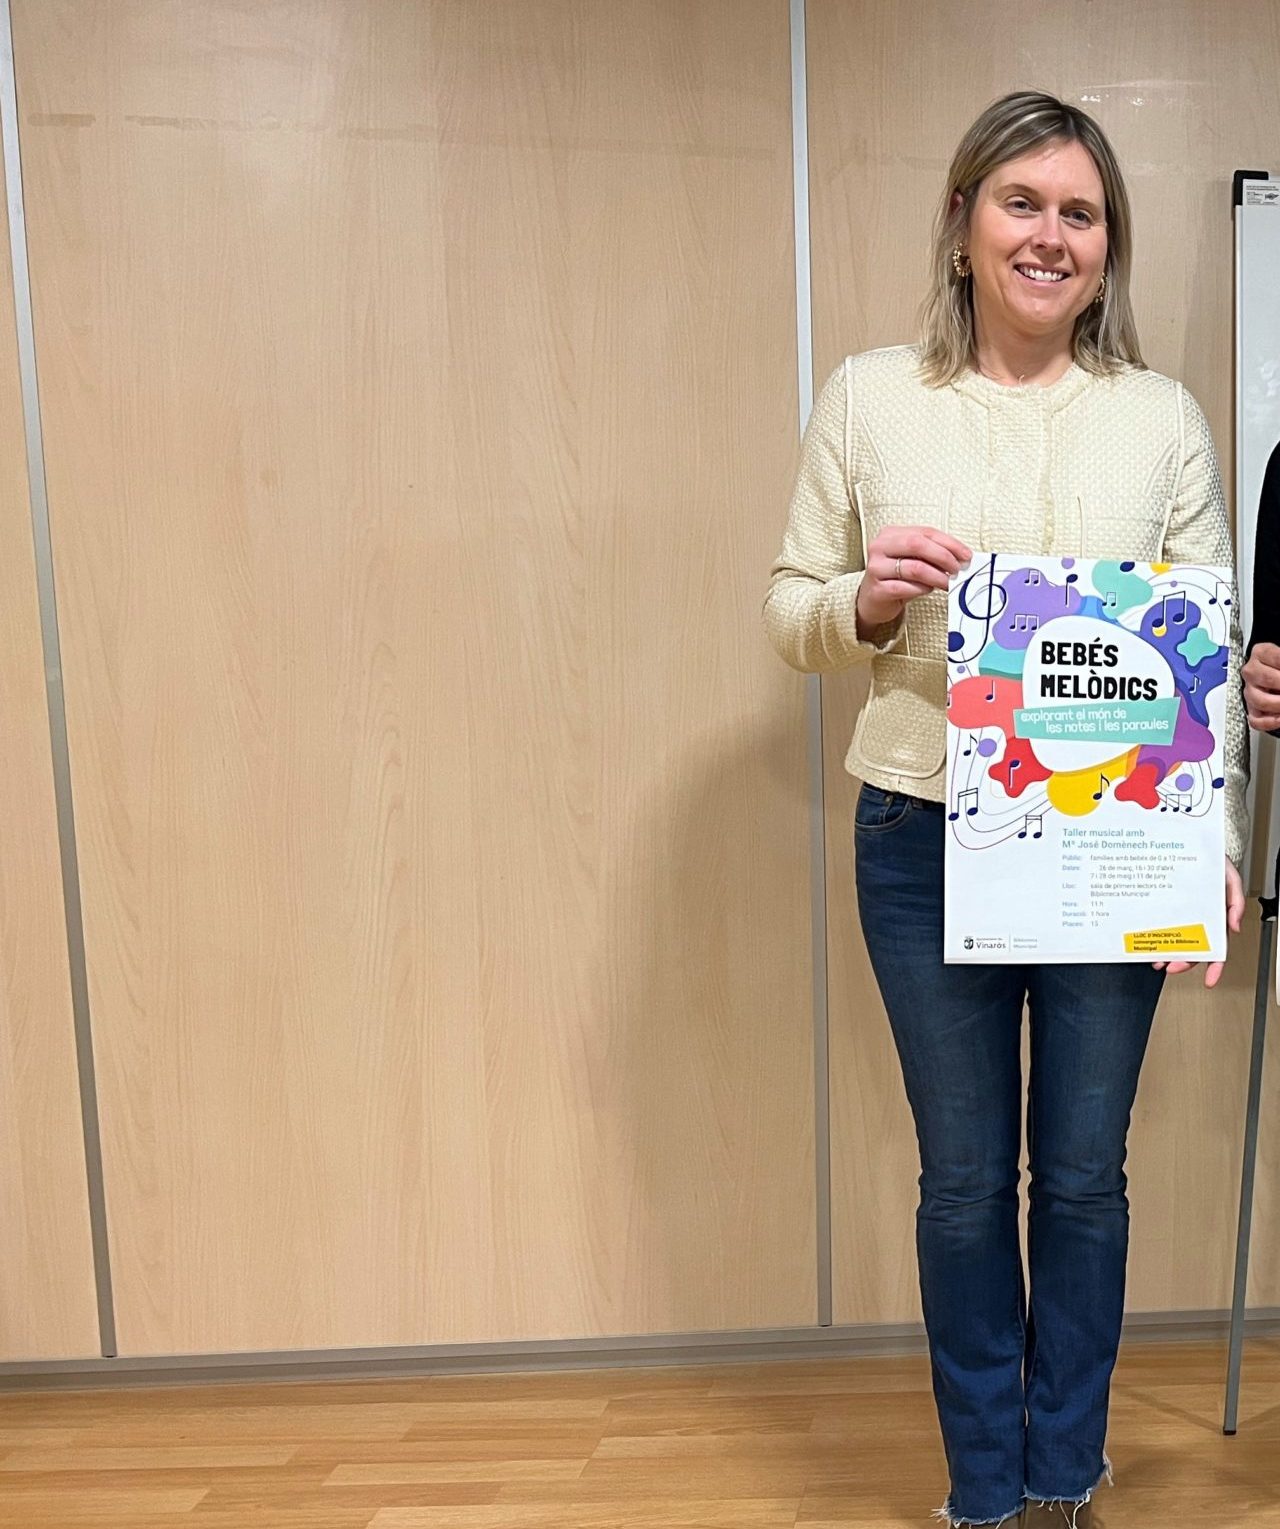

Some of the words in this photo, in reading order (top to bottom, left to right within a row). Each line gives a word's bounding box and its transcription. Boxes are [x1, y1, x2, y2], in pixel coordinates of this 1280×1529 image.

[1041, 636, 1119, 667] BEBÉS
[1040, 668, 1158, 701] MELÒDICS
[1020, 708, 1073, 724] explorant
[1076, 709, 1085, 721] el
[1088, 707, 1111, 721] món
[1114, 707, 1127, 719] de
[1045, 721, 1062, 734] les
[1064, 722, 1096, 732] notes
[1099, 720, 1101, 731] i
[1104, 719, 1120, 731] les
[1122, 718, 1169, 733] paraules
[1063, 828, 1086, 837] Taller
[1089, 828, 1124, 837] musical
[1125, 828, 1145, 837] amb
[1077, 840, 1099, 849] José
[1101, 840, 1148, 849] Domènech
[1150, 841, 1184, 849] Fuentes
